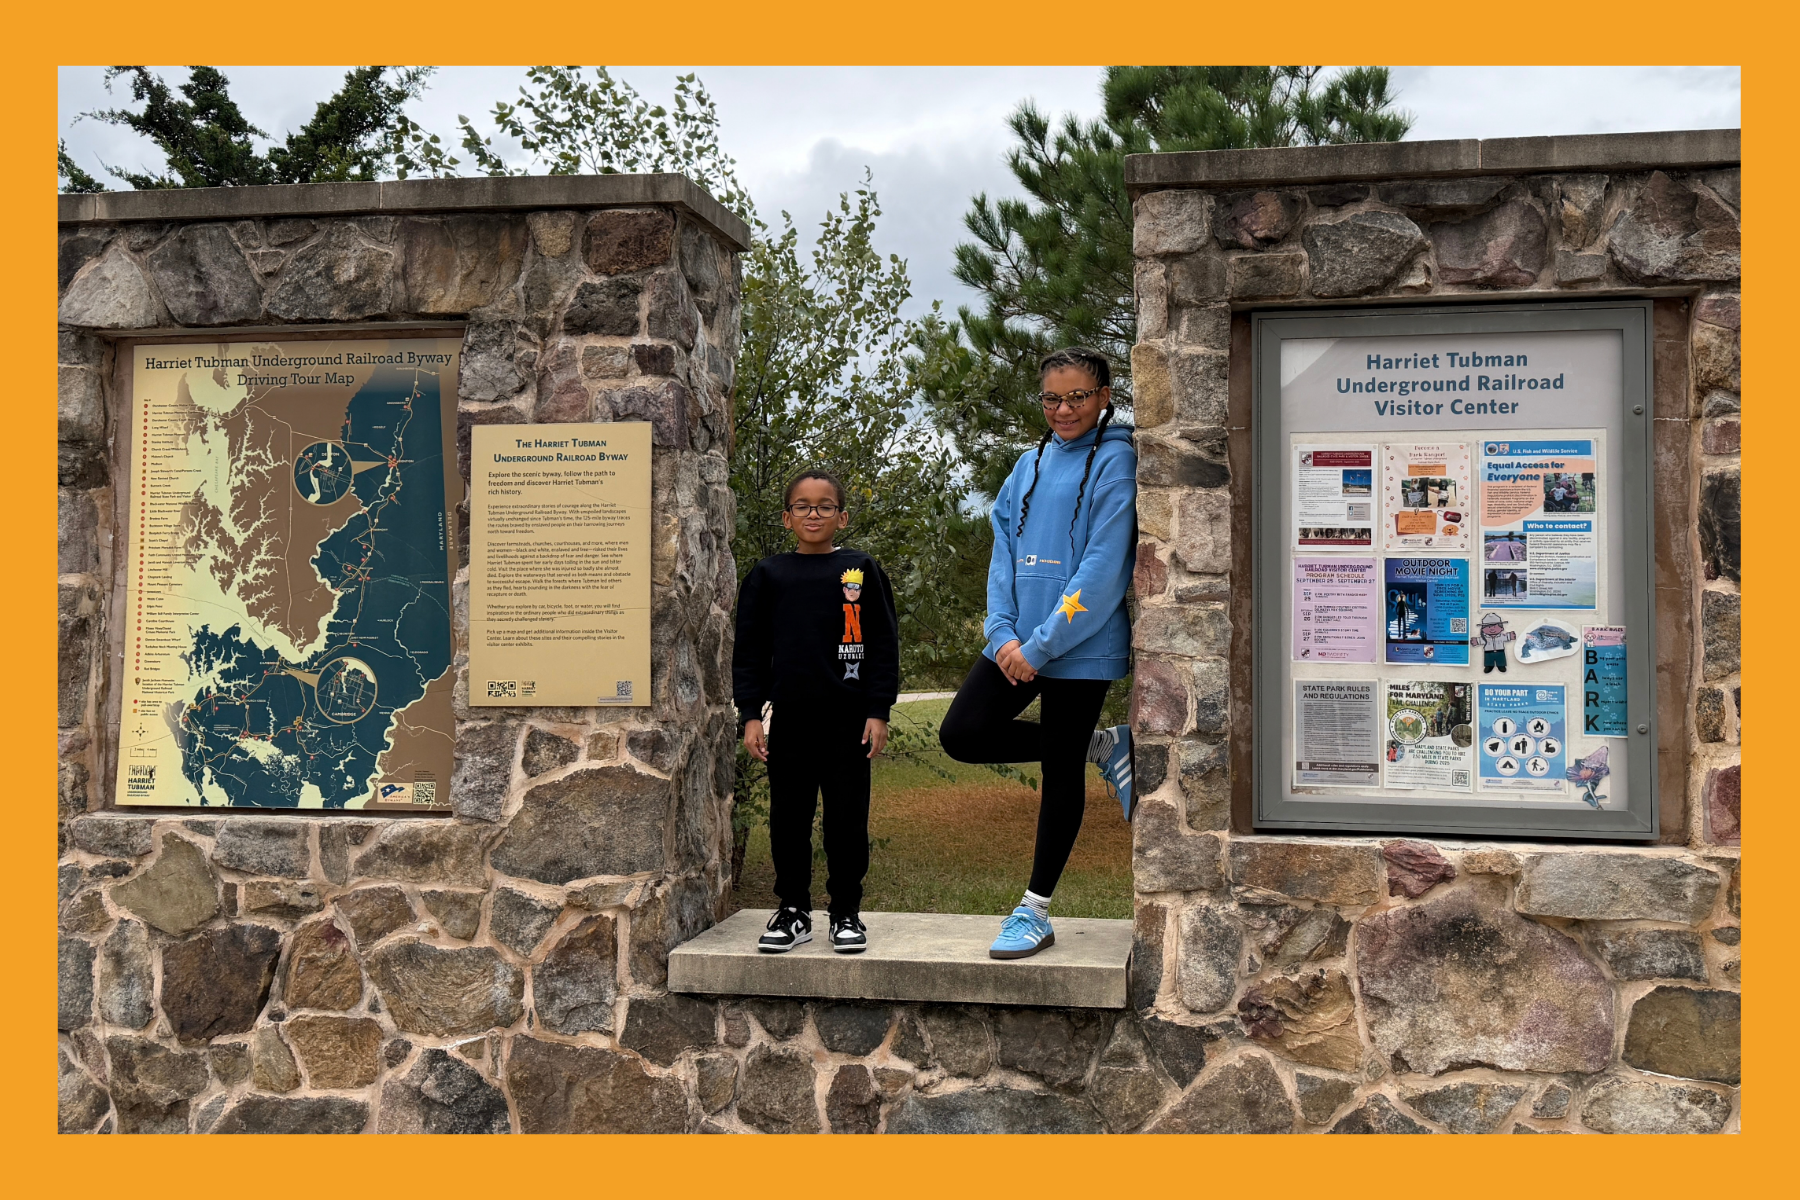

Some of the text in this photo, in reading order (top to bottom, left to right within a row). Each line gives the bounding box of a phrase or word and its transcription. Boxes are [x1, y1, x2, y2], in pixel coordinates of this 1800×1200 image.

[145, 352, 453, 370] Harriet Tubman Underground Railroad Byway
[1366, 351, 1528, 369] Harriet Tubman
[237, 372, 355, 388] Driving Tour Map
[1336, 373, 1565, 395] Underground Railroad
[1375, 400, 1519, 416] Visitor Center
[594, 470, 608, 478] path
[1487, 462, 1514, 471] Equal
[1550, 461, 1565, 469] for
[1487, 473, 1540, 484] Everyone
[1402, 559, 1451, 567] OUTDOOR
[1428, 567, 1459, 575] NIGHT
[842, 603, 862, 643] N
